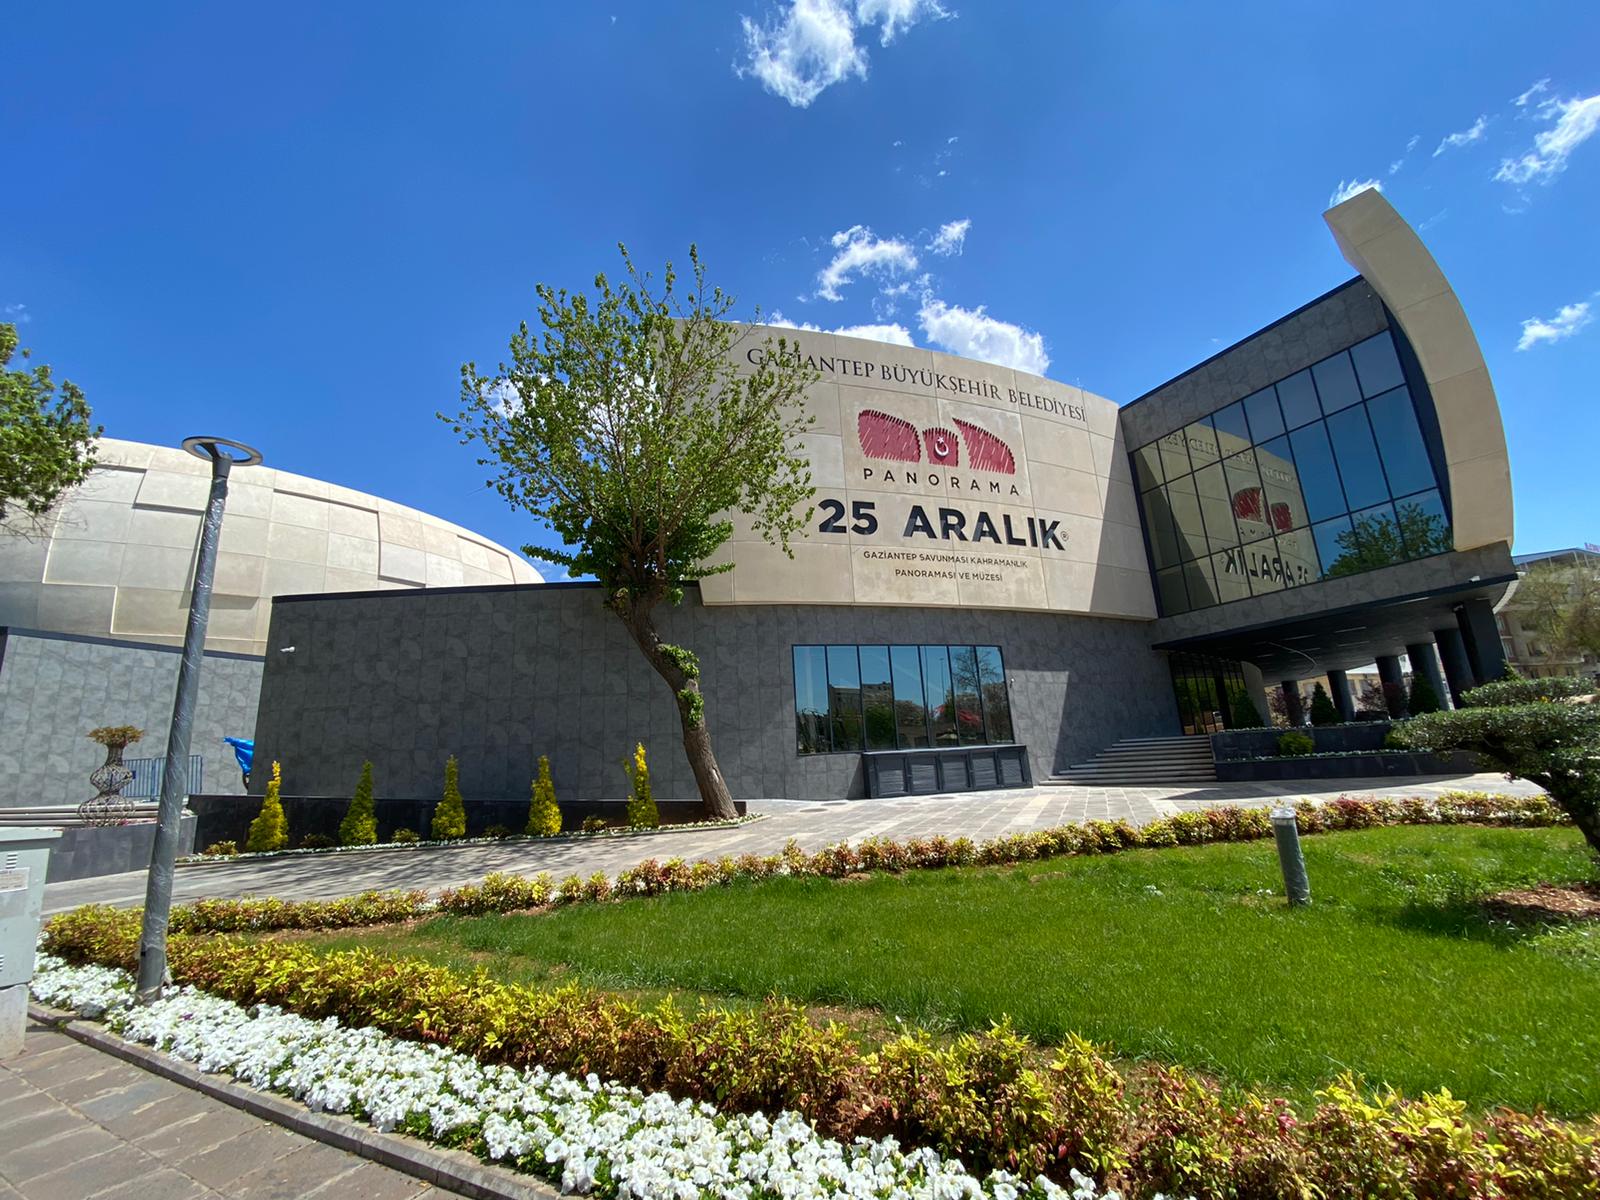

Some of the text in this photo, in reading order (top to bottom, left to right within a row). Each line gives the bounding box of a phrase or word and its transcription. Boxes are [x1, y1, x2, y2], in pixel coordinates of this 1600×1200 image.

[881, 363, 1002, 401] BÜYÜKŞEHİR
[1008, 388, 1086, 422] BELEDİYESİ
[863, 468, 1019, 496] PANORAMA
[818, 498, 1066, 551] 25 ARALIK
[863, 550, 1028, 569] GAZİANTEP SAVUNMASI KAHRAMANLIK
[895, 568, 1003, 582] PANORAMASI VE MÜZESİ
